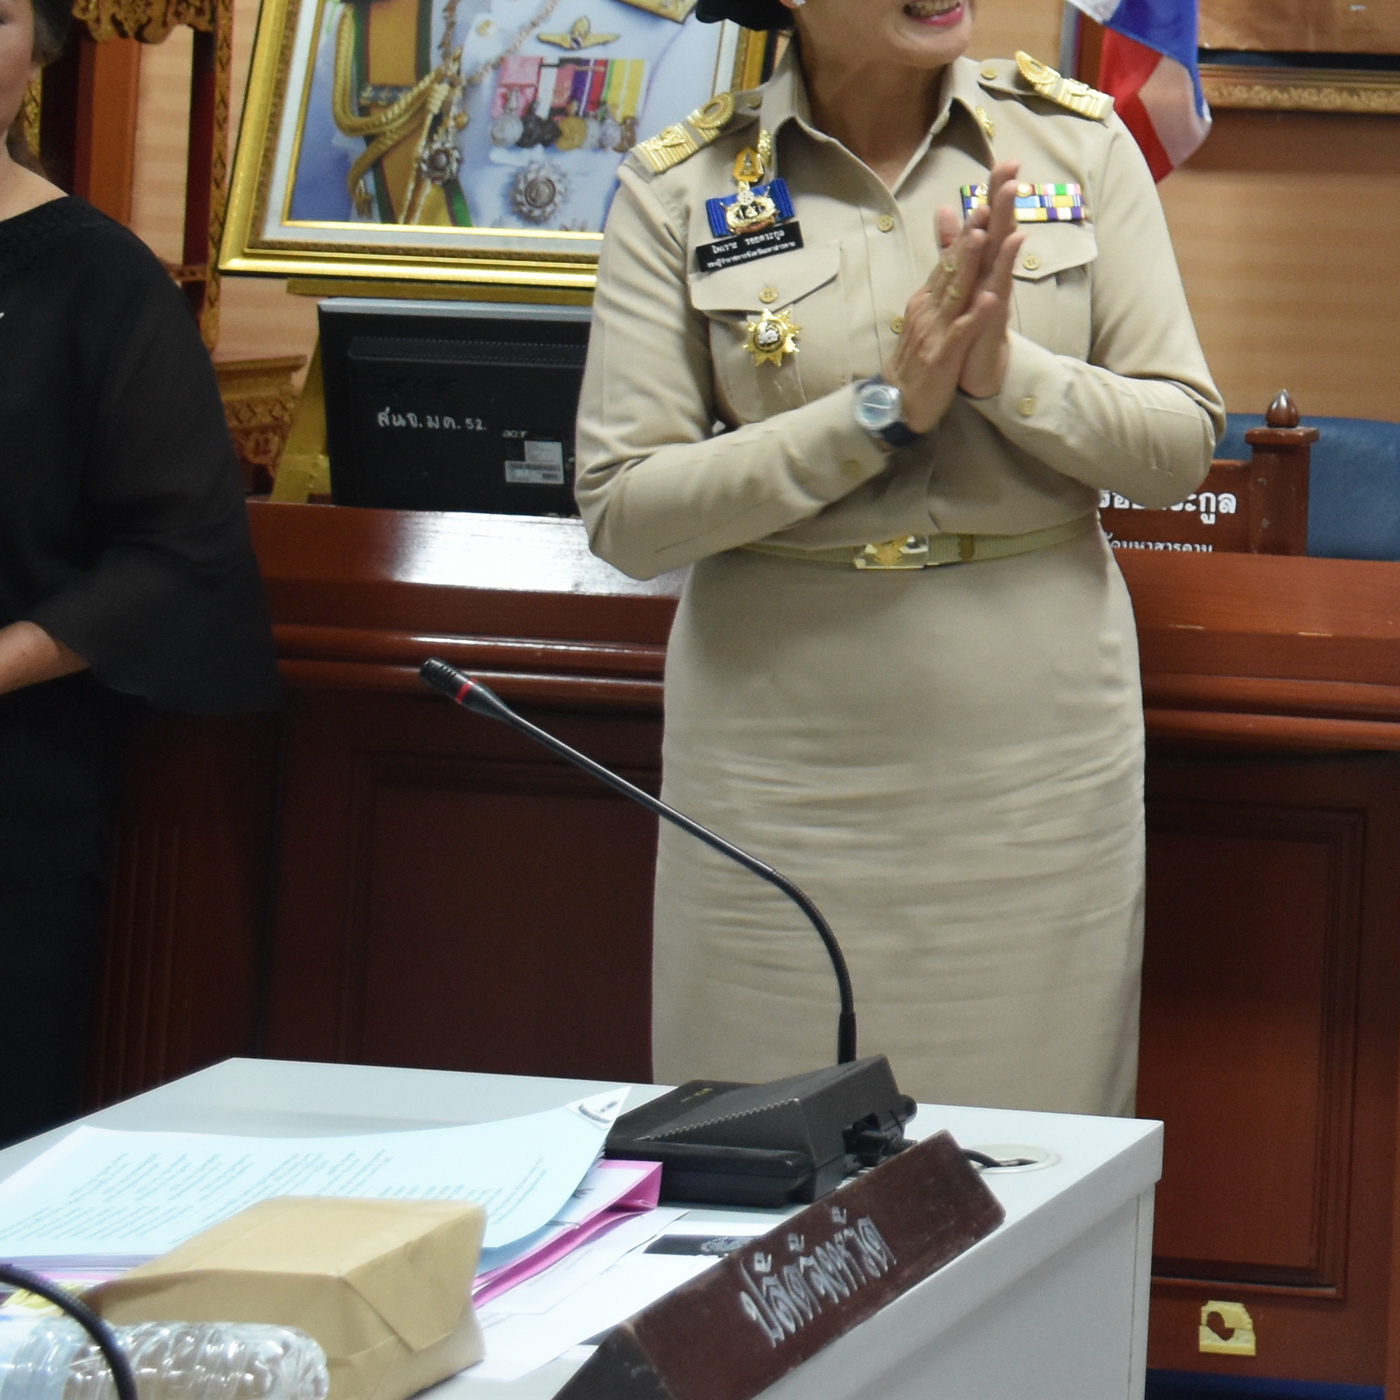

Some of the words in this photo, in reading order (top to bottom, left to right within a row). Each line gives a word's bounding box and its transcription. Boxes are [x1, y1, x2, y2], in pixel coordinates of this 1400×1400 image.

[739, 1205, 897, 1349] ปลัดจังหวัด
